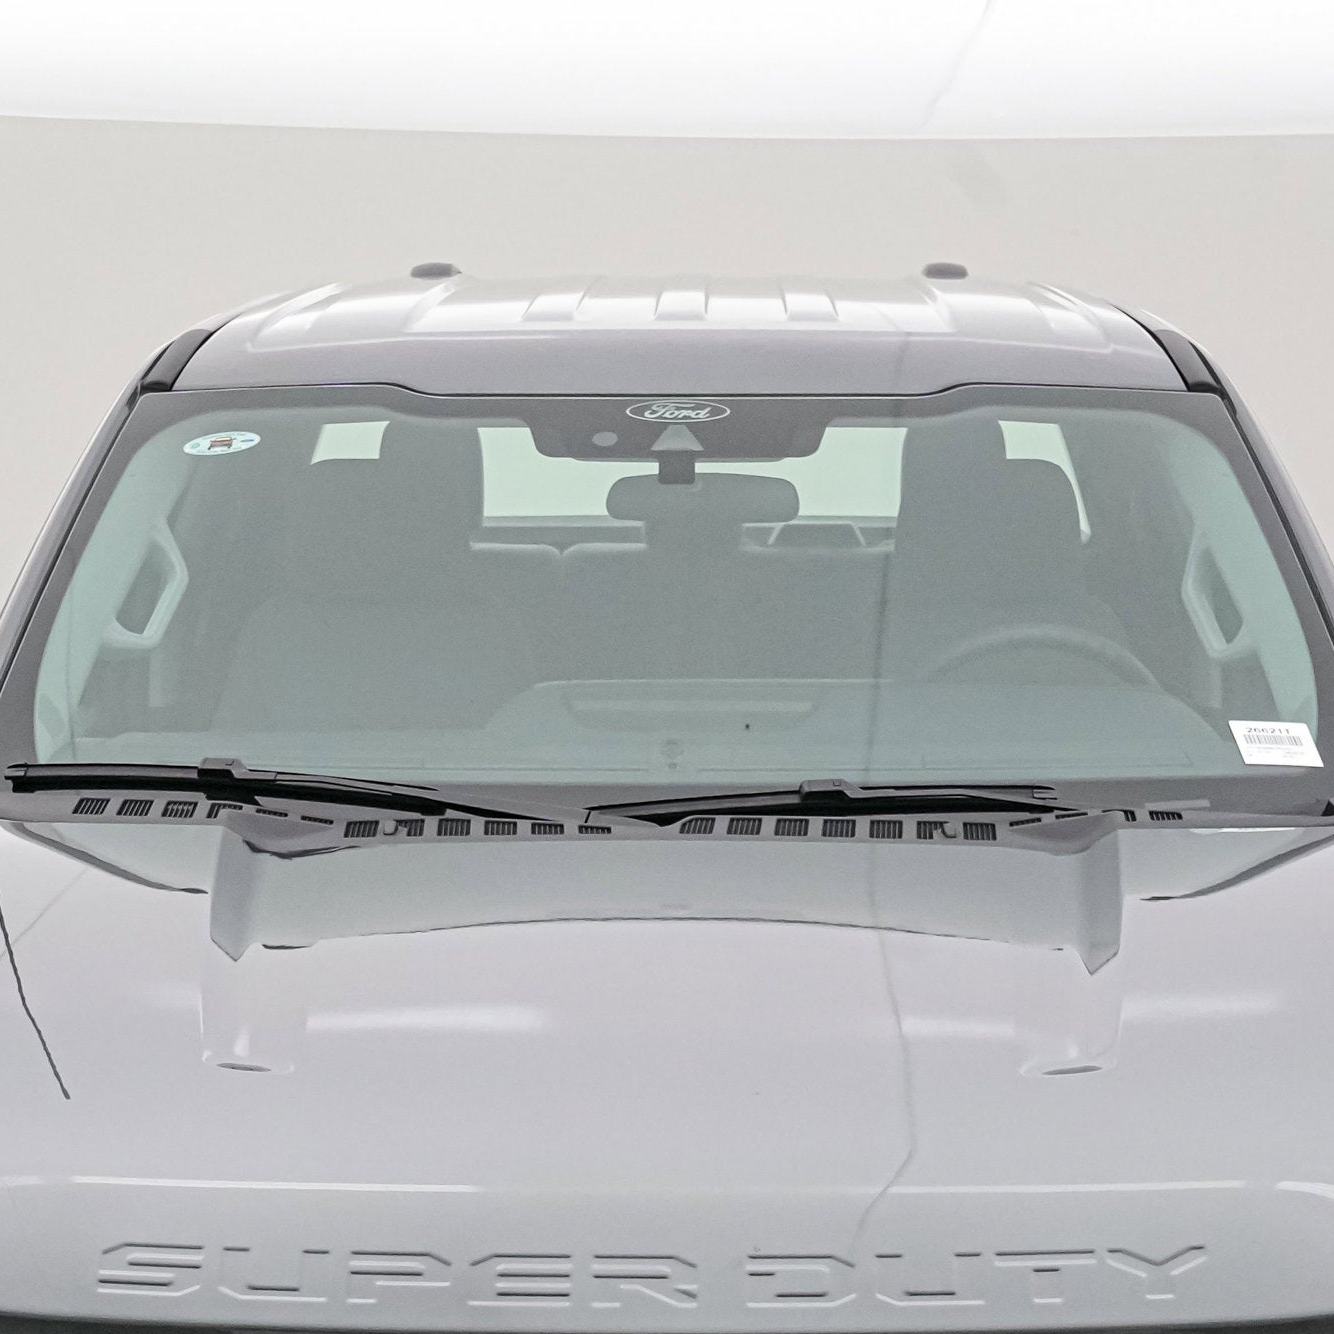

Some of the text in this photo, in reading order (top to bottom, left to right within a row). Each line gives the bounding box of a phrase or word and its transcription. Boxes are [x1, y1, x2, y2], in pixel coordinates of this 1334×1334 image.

[643, 401, 711, 420] Ford
[97, 1242, 1207, 1308] SUPER DUTY
